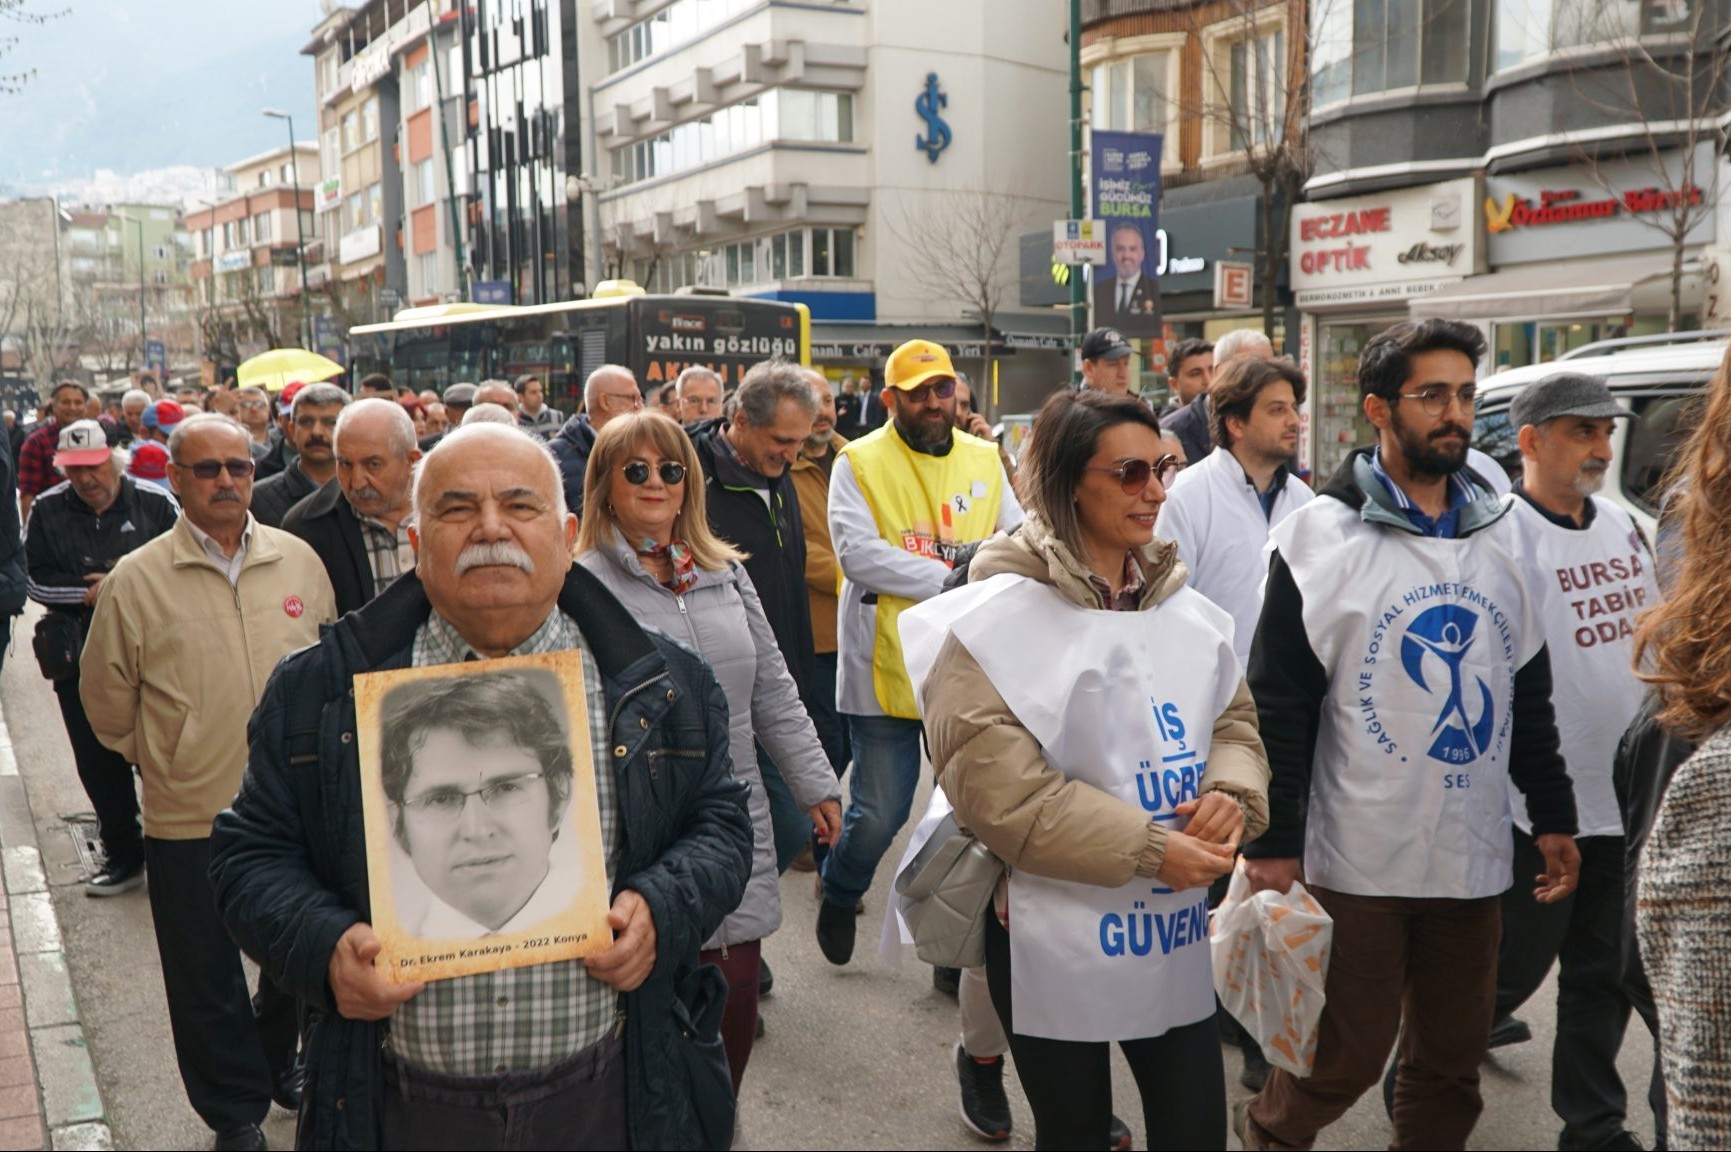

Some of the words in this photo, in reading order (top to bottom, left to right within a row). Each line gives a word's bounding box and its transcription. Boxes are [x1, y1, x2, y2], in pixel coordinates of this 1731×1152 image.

[1099, 202, 1152, 217] BURSA
[1300, 207, 1391, 241] ECZANE
[1055, 240, 1104, 250] OTOPARK
[1397, 242, 1464, 266] Aksoy
[1300, 241, 1371, 275] OPTİK
[1227, 271, 1245, 298] E
[1379, 287, 1401, 297] ANNE
[1406, 284, 1435, 294] BEBEK
[646, 333, 705, 353] yakın
[713, 336, 796, 356] gözlüğü
[853, 343, 882, 357] Cafe
[957, 343, 982, 357] Yeri
[1556, 554, 1643, 593] BURSA
[1402, 583, 1460, 606] HİZMET
[1364, 604, 1404, 665] SOSYAL
[1359, 671, 1373, 691] VE
[1151, 696, 1187, 750] İŞ
[1359, 696, 1398, 754] SAĞLIK
[1444, 774, 1471, 789] SES
[400, 958, 417, 968] Dr.
[420, 953, 456, 966] Ekrem
[459, 944, 512, 958] Karakaya
[523, 938, 550, 949] 2022
[554, 932, 588, 944] Konya
